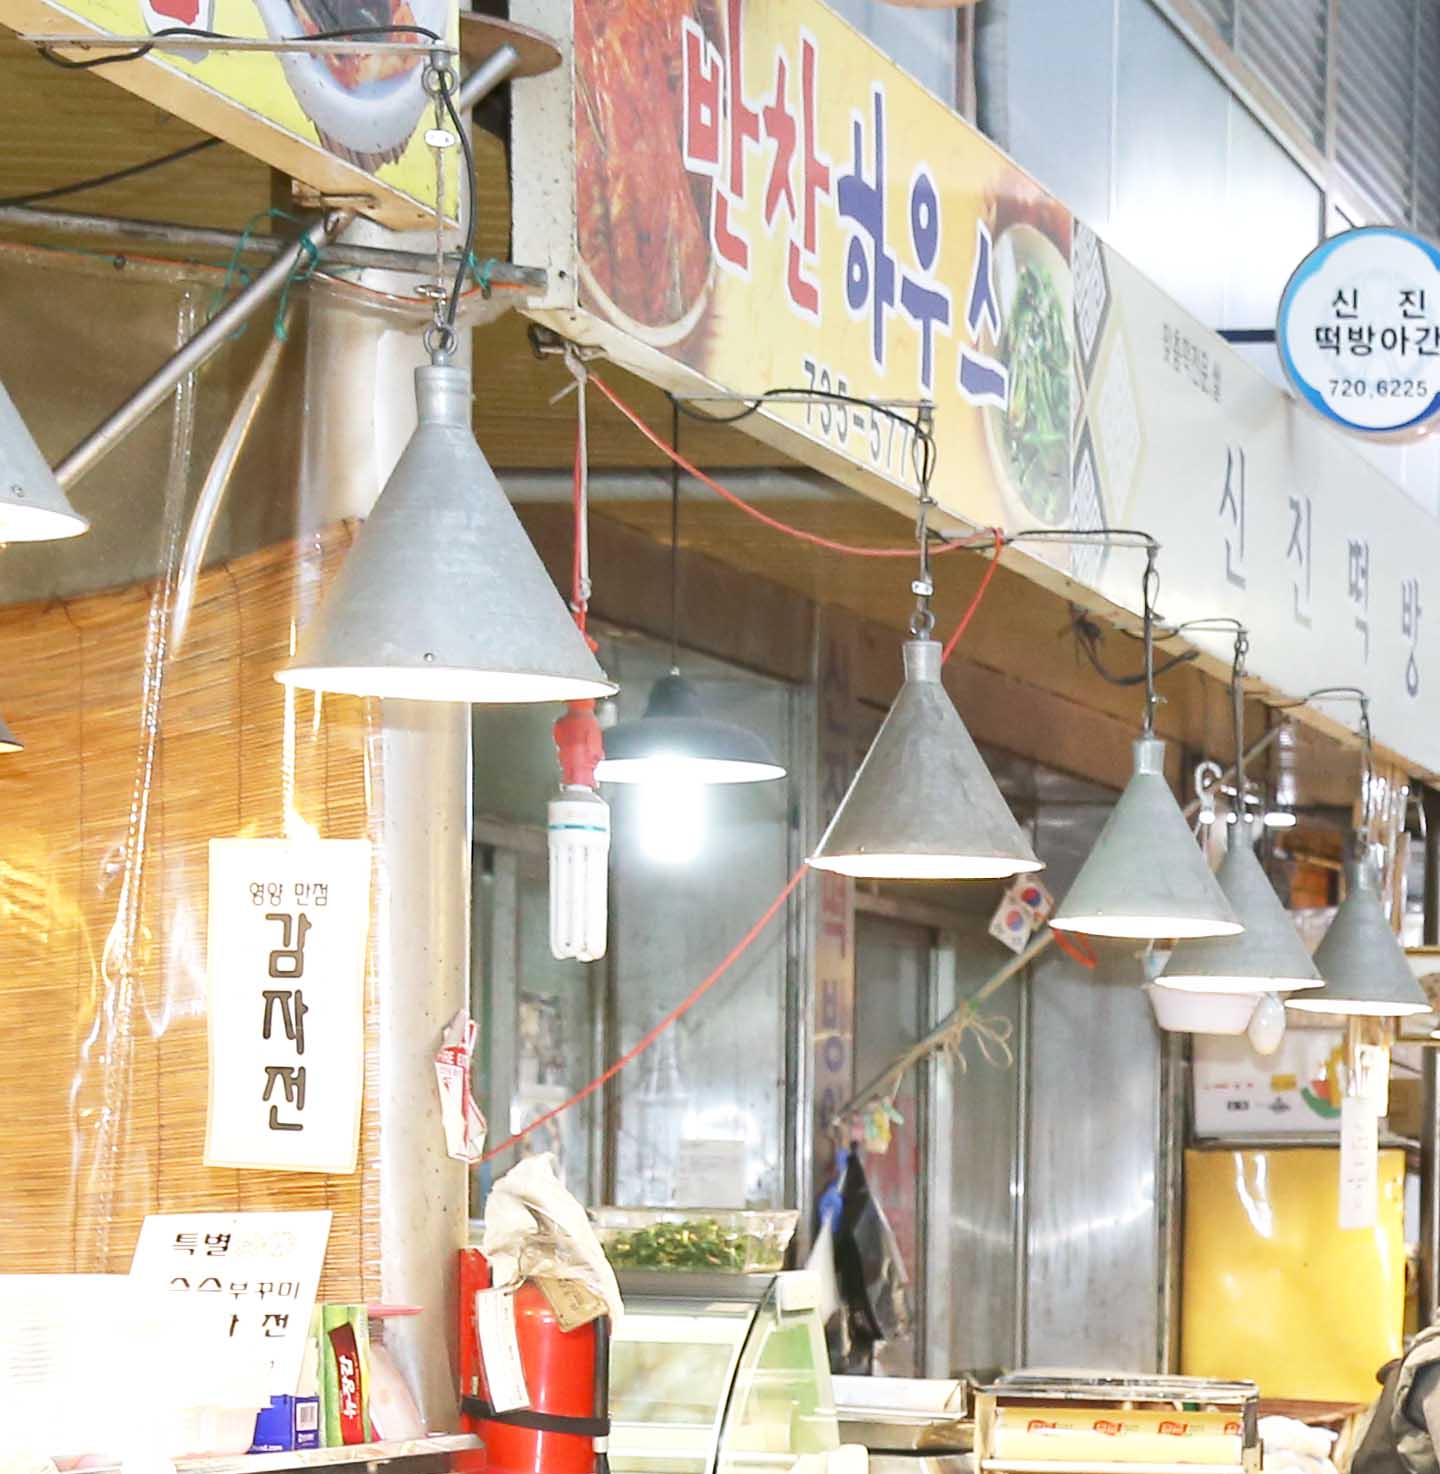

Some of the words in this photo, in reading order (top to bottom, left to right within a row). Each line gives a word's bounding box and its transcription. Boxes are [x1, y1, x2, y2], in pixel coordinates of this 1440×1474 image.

[685, 0, 1008, 404] 반찬하우스
[250, 882, 284, 906] 영양
[262, 912, 313, 1131] 감자전
[172, 1232, 232, 1257] 특별
